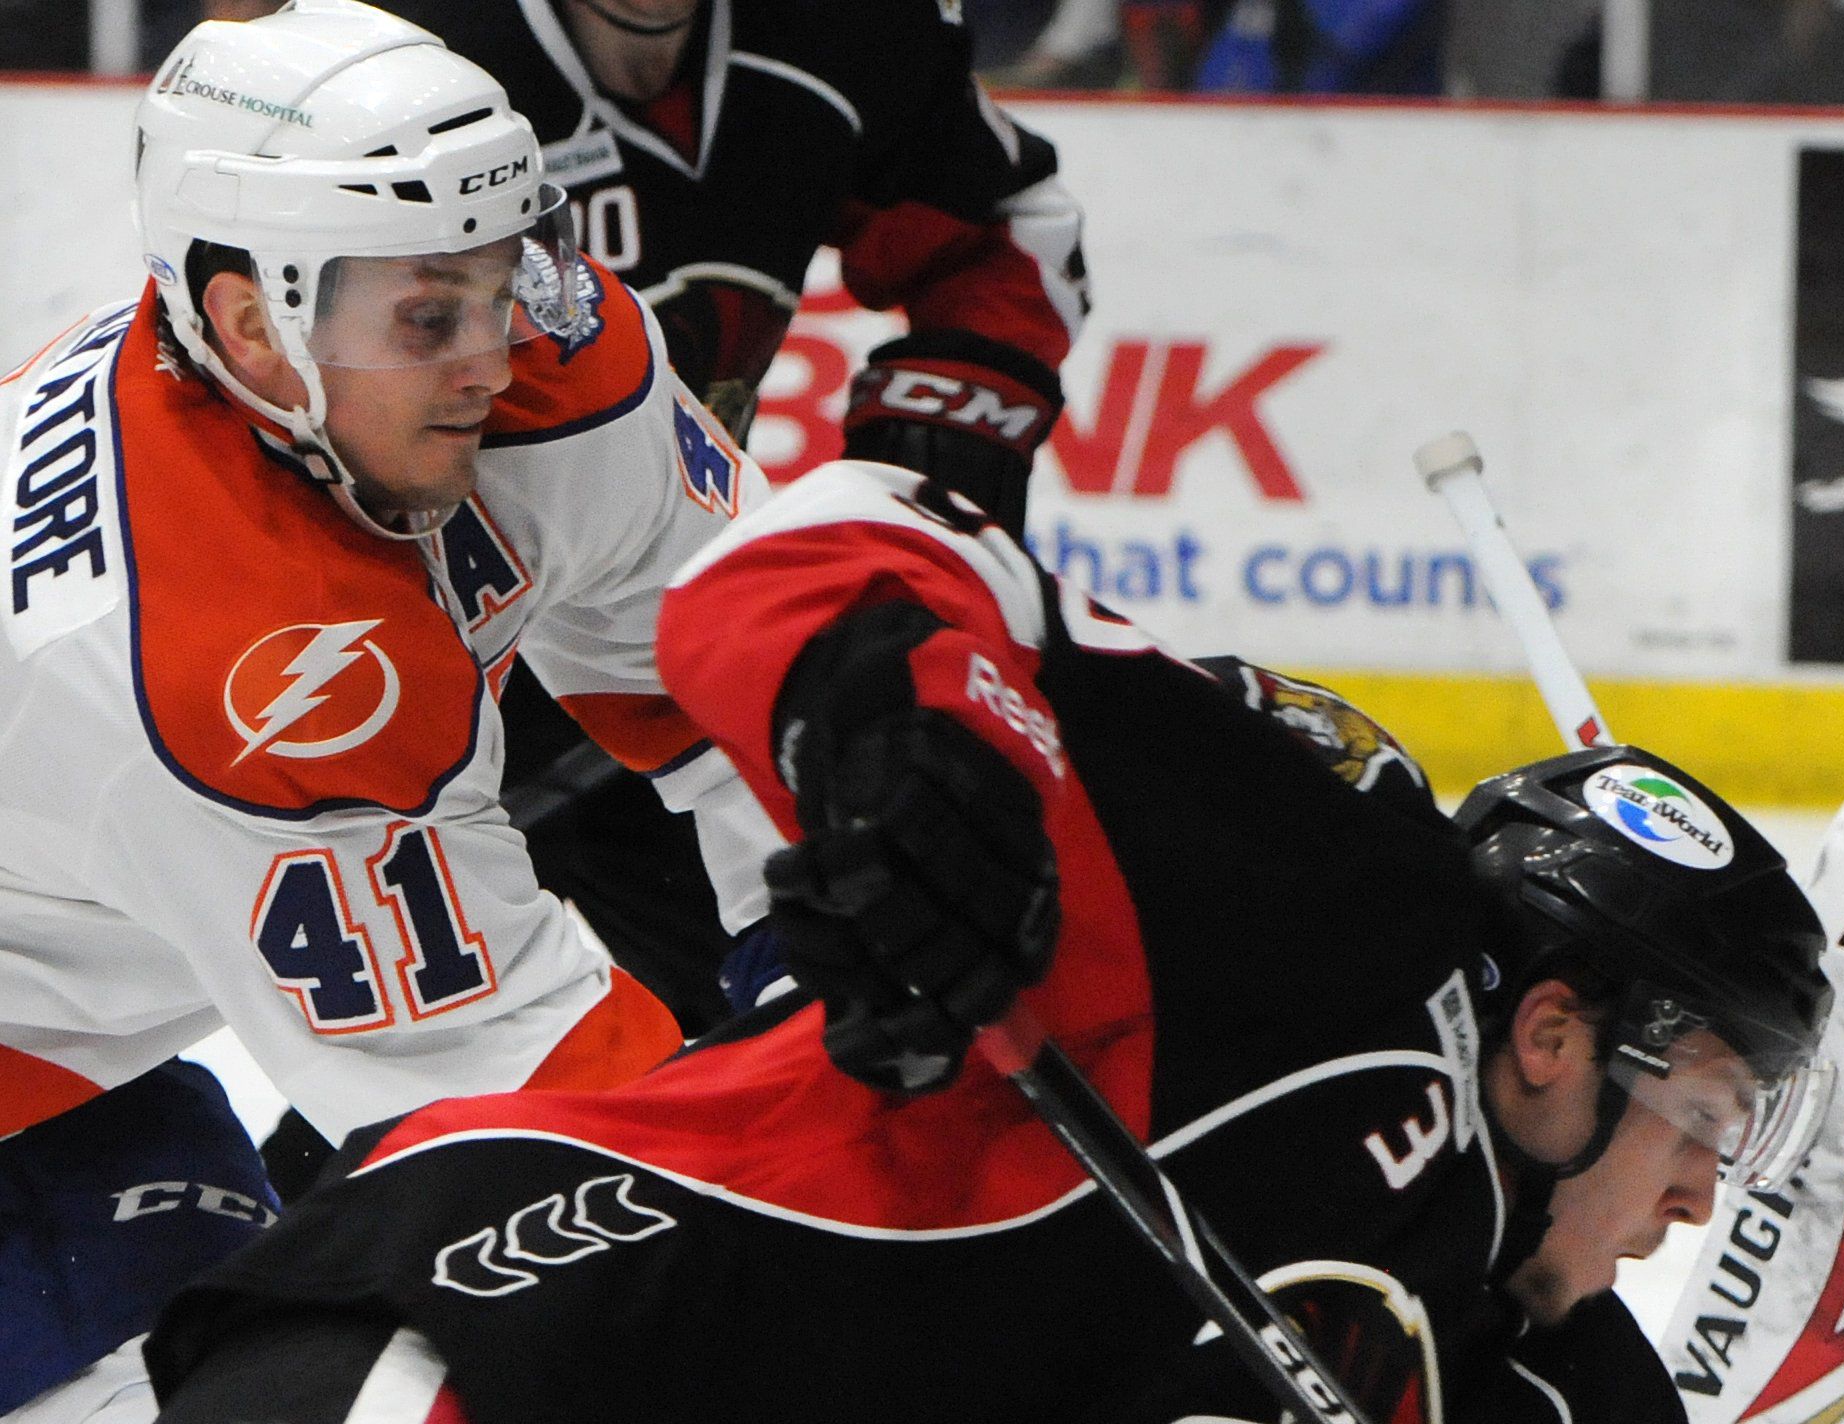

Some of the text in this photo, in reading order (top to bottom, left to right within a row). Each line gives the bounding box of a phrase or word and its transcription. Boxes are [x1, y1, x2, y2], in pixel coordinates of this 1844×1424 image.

[186, 80, 313, 128] CROUSE HOSPITAL
[459, 155, 528, 195] CCM
[1243, 545, 1567, 611] couns
[250, 820, 498, 1035] 41
[1364, 1080, 1453, 1190] 3
